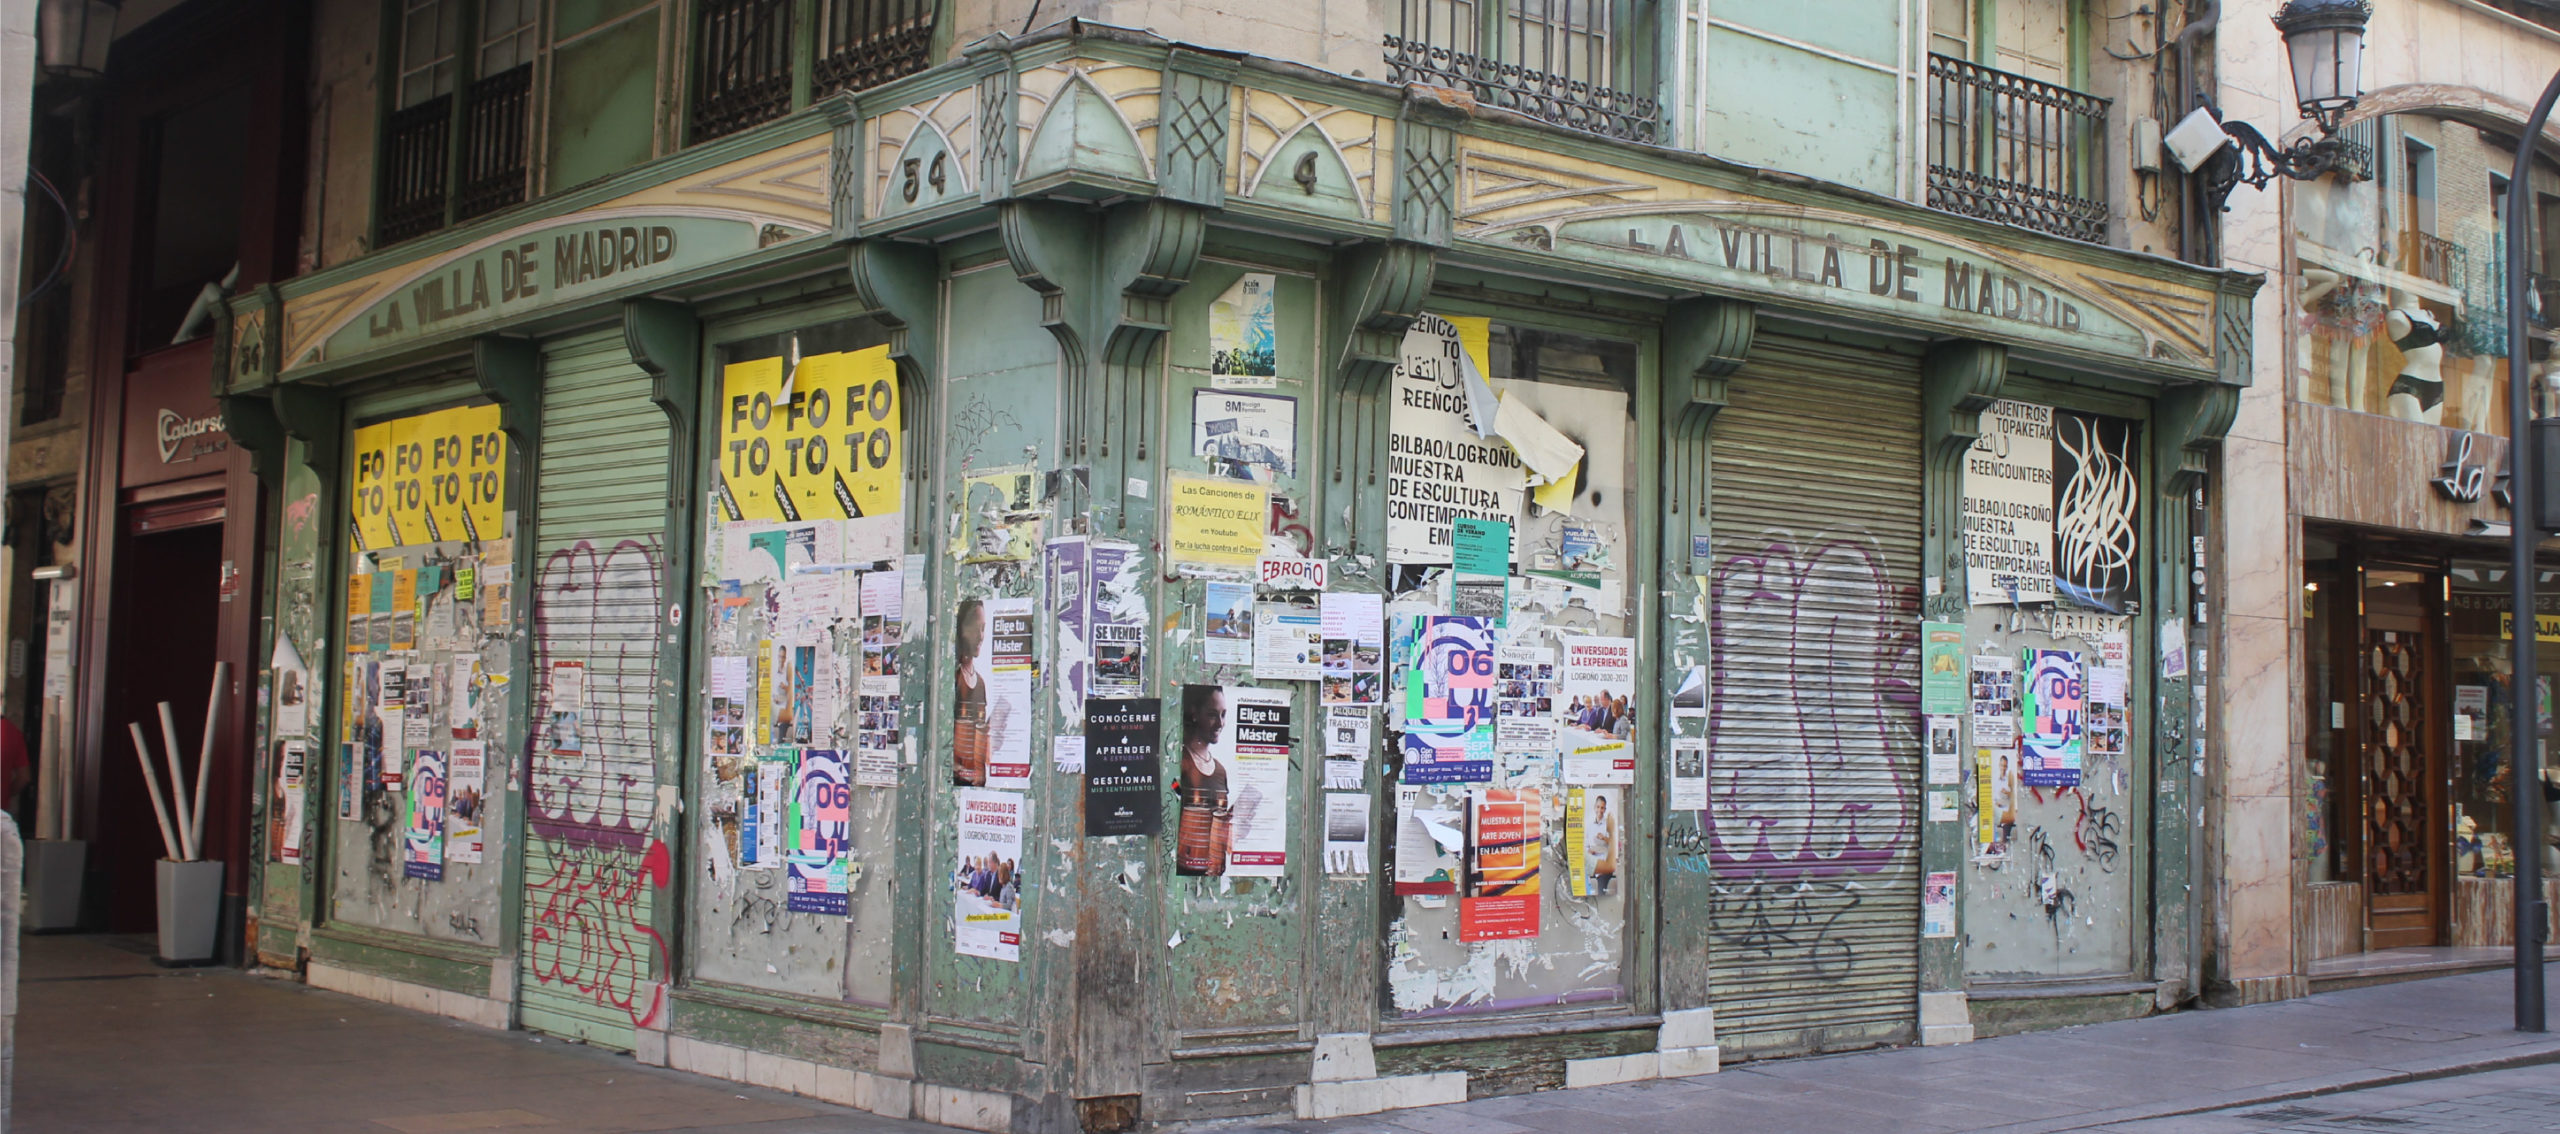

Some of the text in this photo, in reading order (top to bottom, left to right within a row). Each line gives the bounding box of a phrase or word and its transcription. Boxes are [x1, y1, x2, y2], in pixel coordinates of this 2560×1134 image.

[369, 225, 678, 338] LA VILLA DE MADRID
[1628, 224, 2085, 331] LA VILLA DE MADRID
[1441, 339, 1460, 360] TO
[731, 391, 772, 433] FO
[786, 387, 831, 432] FO
[846, 379, 893, 426] FO
[1224, 401, 1242, 413] 8M
[1996, 417, 2053, 441] TOPAKETAK
[396, 441, 422, 476] FO
[433, 434, 462, 469] FO
[470, 431, 500, 467] FO
[729, 436, 770, 478] TO
[785, 434, 829, 478] TO
[844, 427, 892, 473] TO
[1390, 433, 1522, 470] BILBAO/LOGROÑO
[359, 449, 385, 483] FO
[1213, 461, 1229, 477] 17
[1389, 455, 1465, 483] MUESTRA
[1970, 458, 2053, 485] REENCOUNTERS
[2442, 431, 2486, 501] La
[394, 478, 421, 511] TO
[432, 471, 460, 506] TO
[469, 470, 499, 505] TO
[834, 480, 856, 517] CURSOS
[1182, 485, 1255, 500] Las Canciones de
[1389, 478, 1500, 510] DE ESCULTURA
[358, 484, 384, 517] TO
[719, 484, 738, 520] CURSOS
[774, 484, 794, 521] CURSOS
[1963, 496, 2052, 523] BILBAO/LOGROÑO
[1175, 504, 1261, 521] ROMÁNTICO ELIX
[1210, 527, 1238, 537] Youtube
[1963, 515, 2015, 536] MUESTRA
[1175, 540, 1186, 549] Por
[1187, 541, 1193, 549] la
[1194, 541, 1210, 550] lucha
[1212, 543, 1232, 552] contra
[1233, 544, 1239, 552] el
[1963, 533, 2040, 557] DE ESCULTURA
[1964, 551, 2051, 576] CONTEMPORÁNEA
[994, 617, 1025, 635] Elige tu
[1095, 625, 1142, 640] SE VENDE
[993, 639, 1024, 653] Máster
[1571, 645, 1628, 657] UNIVERSIDAD DE
[1448, 649, 1494, 676] 06
[1571, 656, 1628, 668] LA EXPERIENCIA
[1571, 671, 1629, 682] LOGROÑO 2020-2021
[2051, 677, 2082, 700] 06
[1090, 713, 1156, 723] CONOCERME
[1239, 707, 1280, 724] Elige tu
[1333, 706, 1368, 717] ALQUILER
[1238, 727, 1278, 742] Máster
[1329, 718, 1369, 730] TRASTEROS
[1095, 745, 1151, 755] APRENDER
[424, 776, 447, 798] 06
[1092, 775, 1153, 785] GESTIONAR
[1105, 785, 1155, 793] SENTIMIENTOS
[816, 782, 850, 809] 06
[965, 800, 1017, 815] UNIVERSIDAD DE
[964, 813, 1017, 828] LA EXPERIENCIA
[1480, 816, 1521, 825] MUESTRA DE
[964, 829, 1016, 844] LOGROÑO 2020-2021
[1481, 831, 1521, 840] ARTE JOVEN
[1479, 846, 1521, 856] EN LA RIOJA
